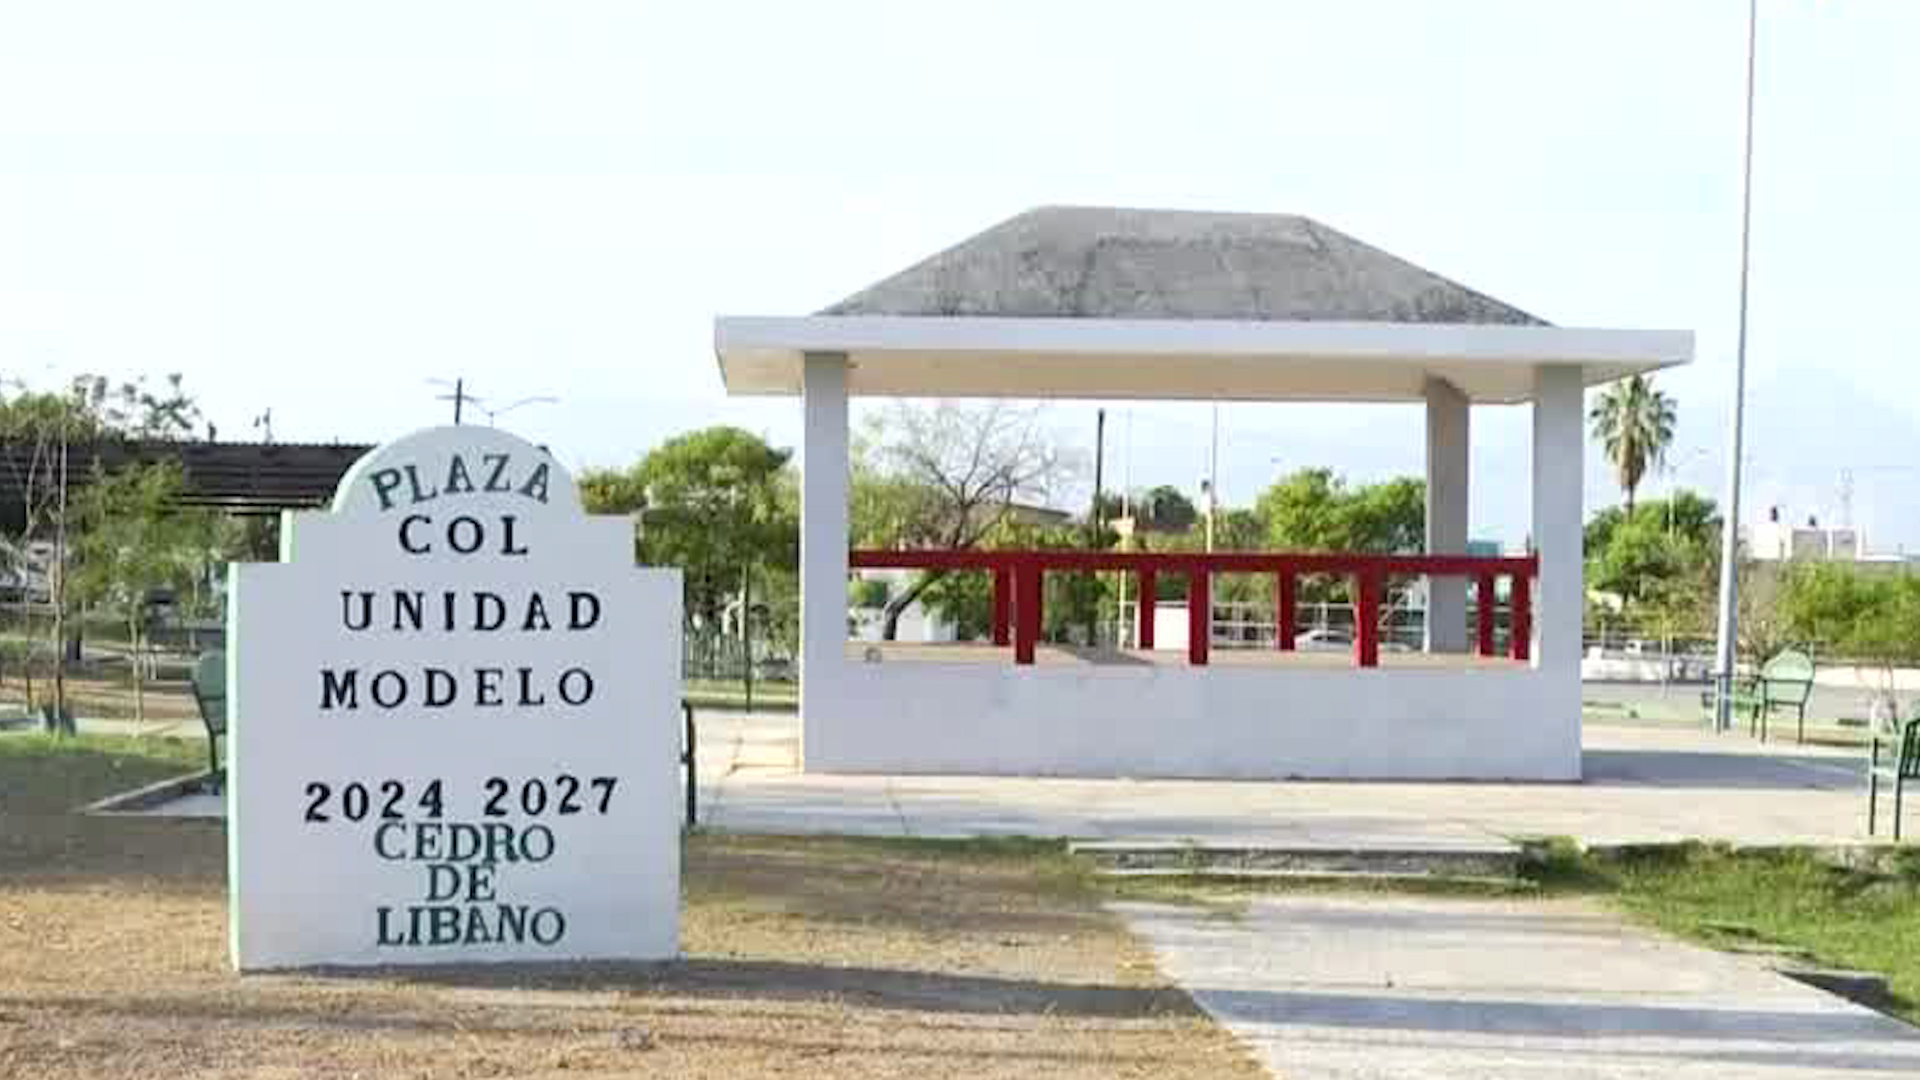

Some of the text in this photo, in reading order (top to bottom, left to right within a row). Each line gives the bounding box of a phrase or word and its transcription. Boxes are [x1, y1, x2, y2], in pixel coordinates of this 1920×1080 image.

[368, 453, 551, 512] PLAZA
[398, 514, 529, 556] COL
[340, 589, 601, 633] UNIDAD
[319, 667, 595, 711] MODELO
[304, 773, 618, 824] 2024 2027
[373, 821, 556, 863] CEDRO
[425, 862, 496, 904] DE
[376, 903, 567, 948] LIBANO
